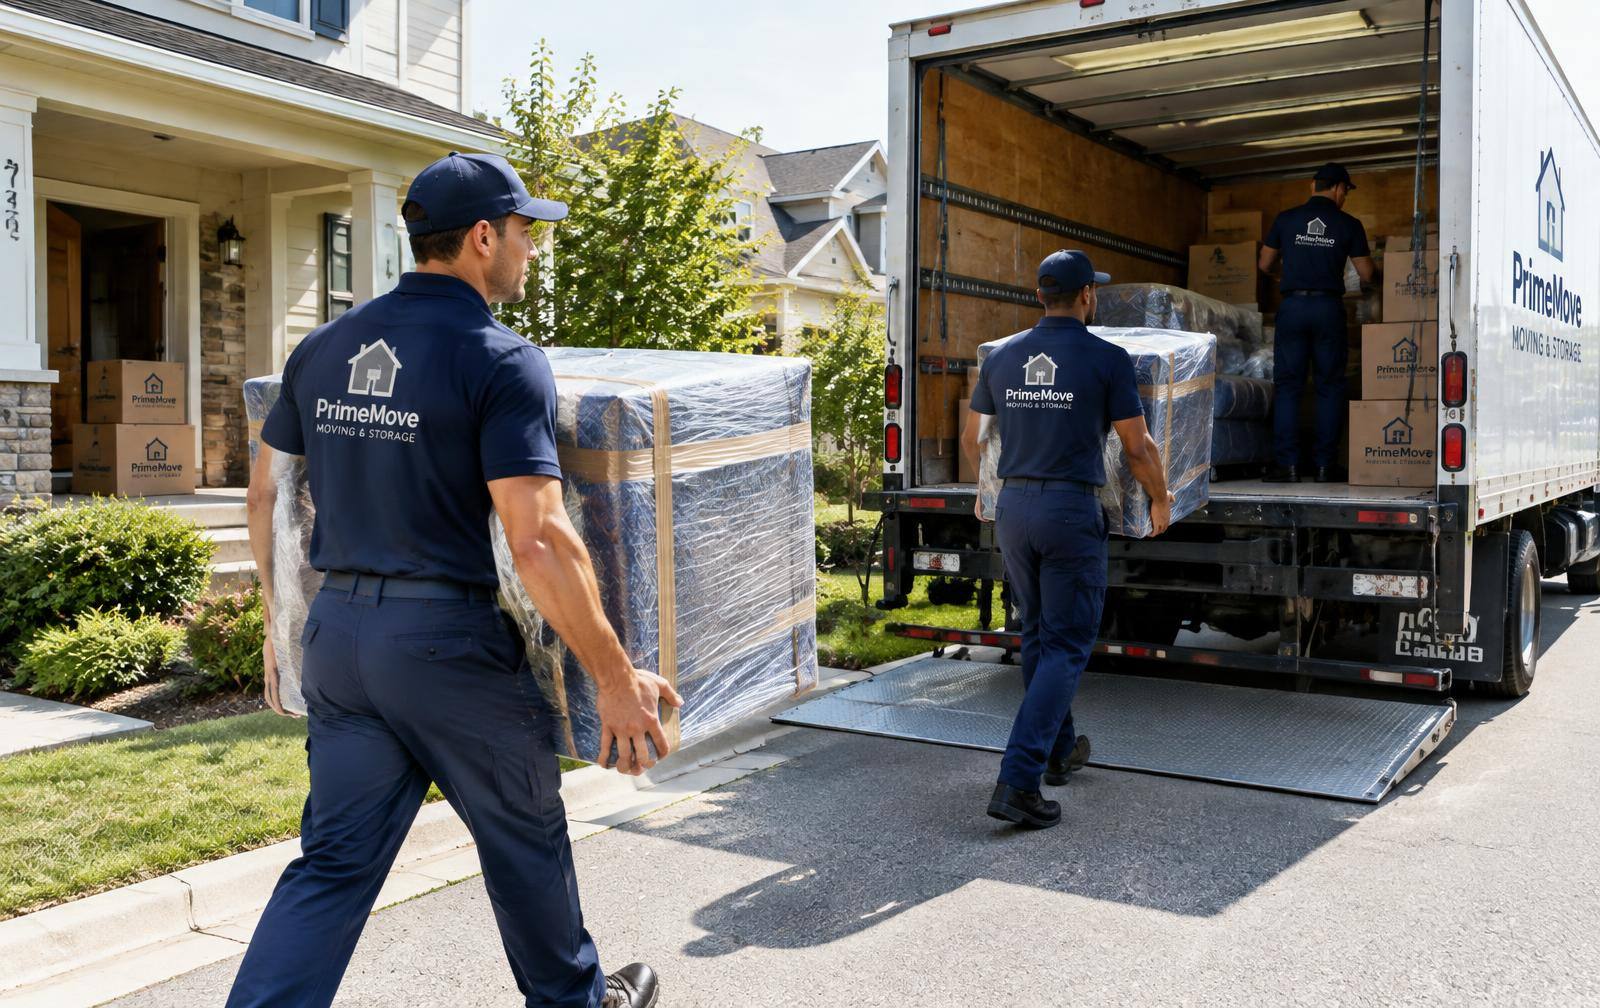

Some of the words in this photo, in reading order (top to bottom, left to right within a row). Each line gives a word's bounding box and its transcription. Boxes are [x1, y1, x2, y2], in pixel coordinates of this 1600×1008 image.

[1512, 250, 1582, 329] PrimeMove
[1512, 325, 1544, 356] MOVING
[1553, 337, 1582, 363] STORAGE
[1005, 388, 1074, 402] PrimeMove
[316, 398, 419, 428] PrimeMove
[316, 423, 355, 437] MOVING
[369, 429, 416, 443] STORAGE
[1364, 446, 1433, 458] PrimeMove
